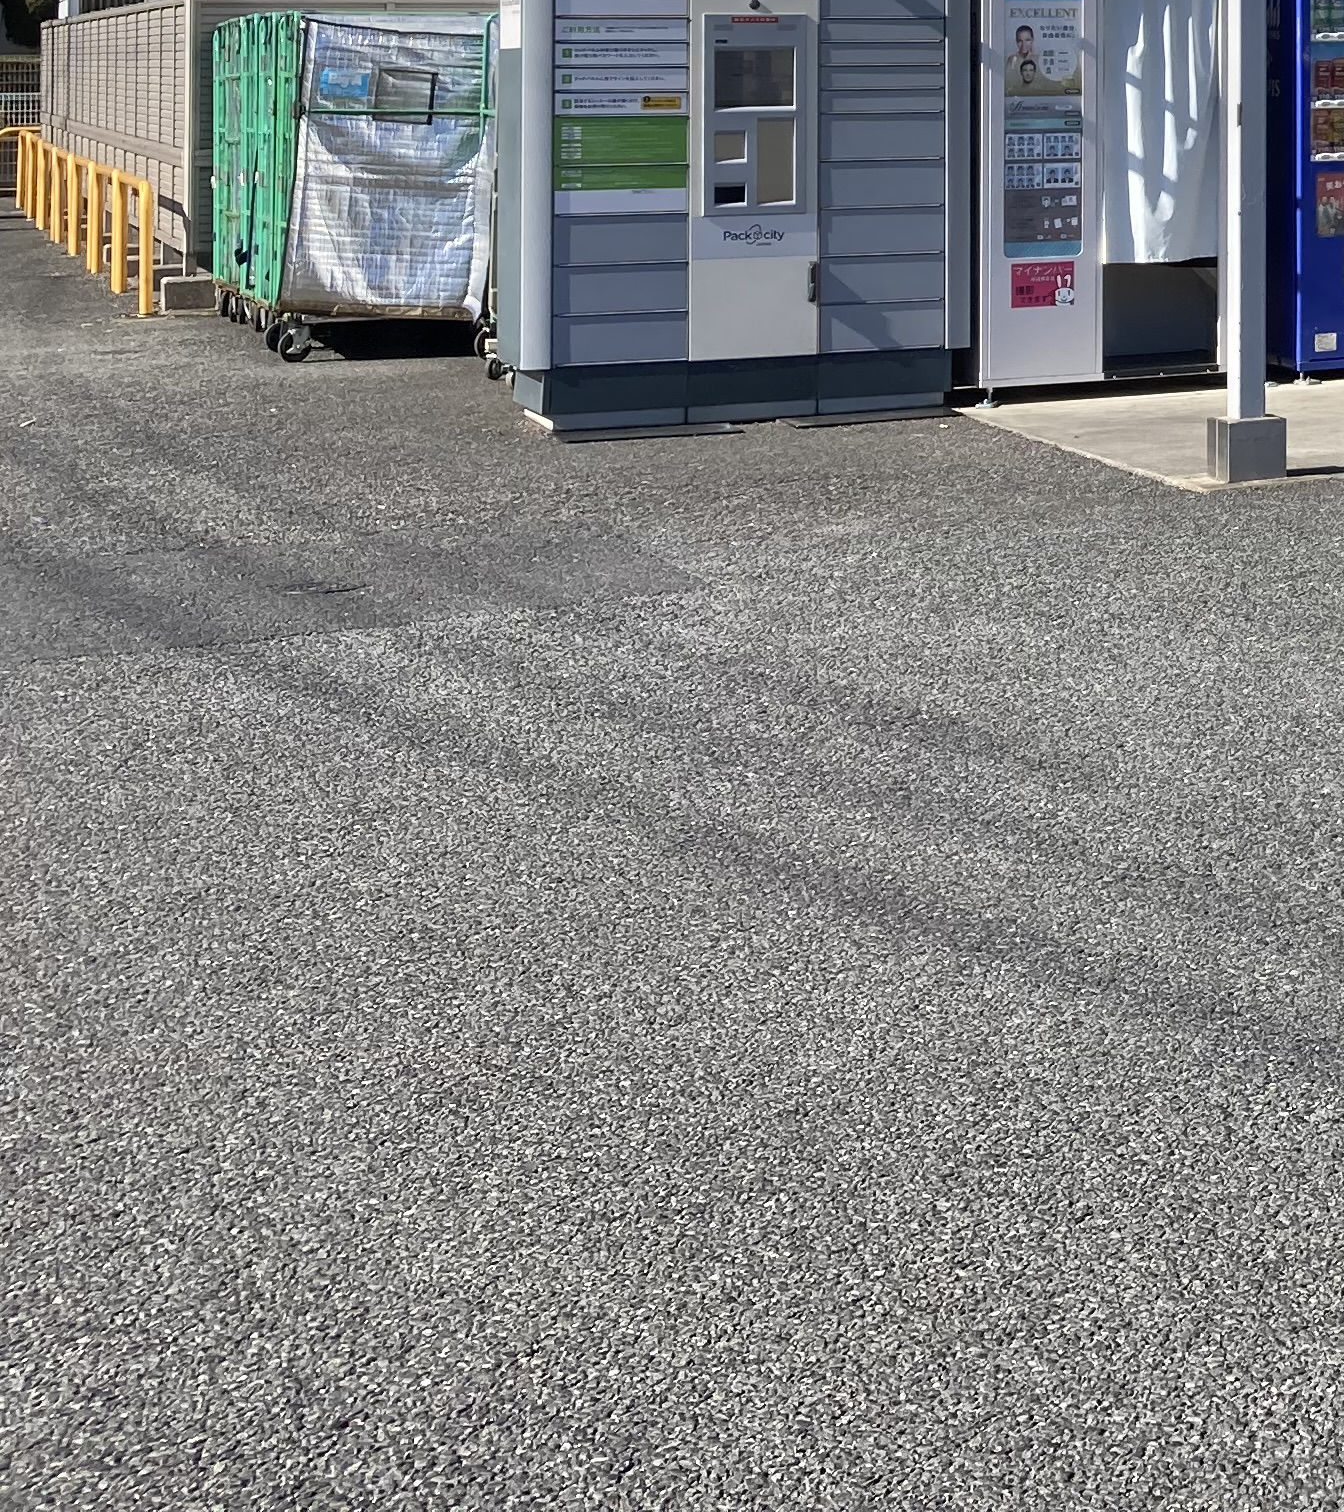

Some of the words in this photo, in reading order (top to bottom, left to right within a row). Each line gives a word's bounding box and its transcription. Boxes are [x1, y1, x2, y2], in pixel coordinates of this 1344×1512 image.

[1009, 7, 1079, 19] EXCELLENT
[1013, 265, 1073, 276] マイナンバー
